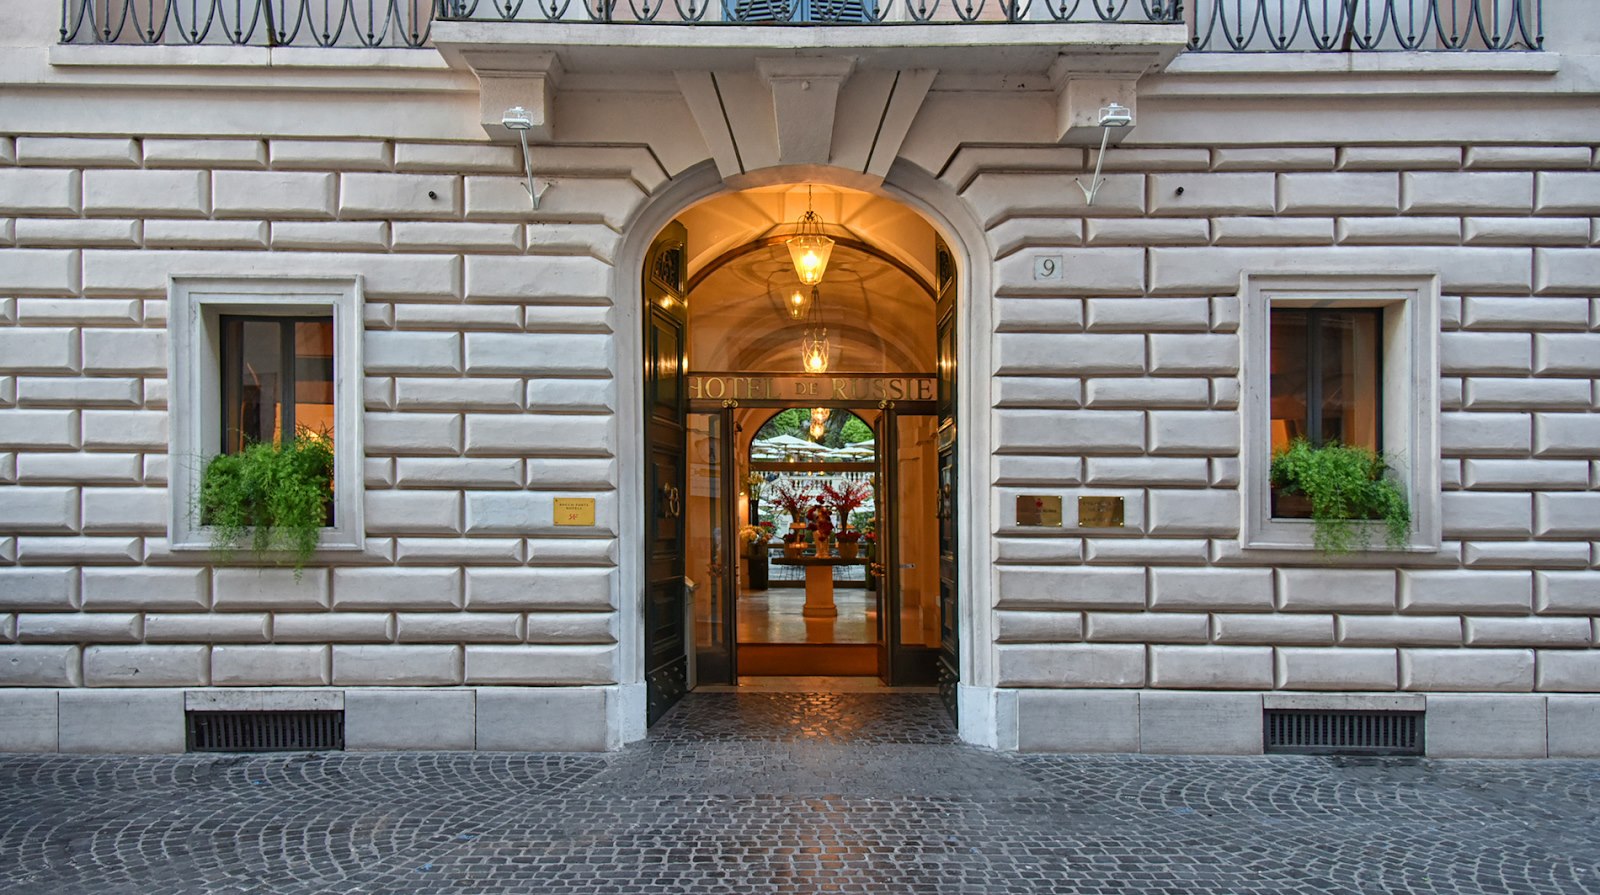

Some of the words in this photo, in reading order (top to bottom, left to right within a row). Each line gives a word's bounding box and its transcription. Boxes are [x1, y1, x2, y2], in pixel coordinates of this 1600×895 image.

[1040, 258, 1055, 277] 9
[689, 377, 781, 399] HOTEL
[794, 382, 818, 395] DE
[831, 378, 933, 400] RUSSIE
